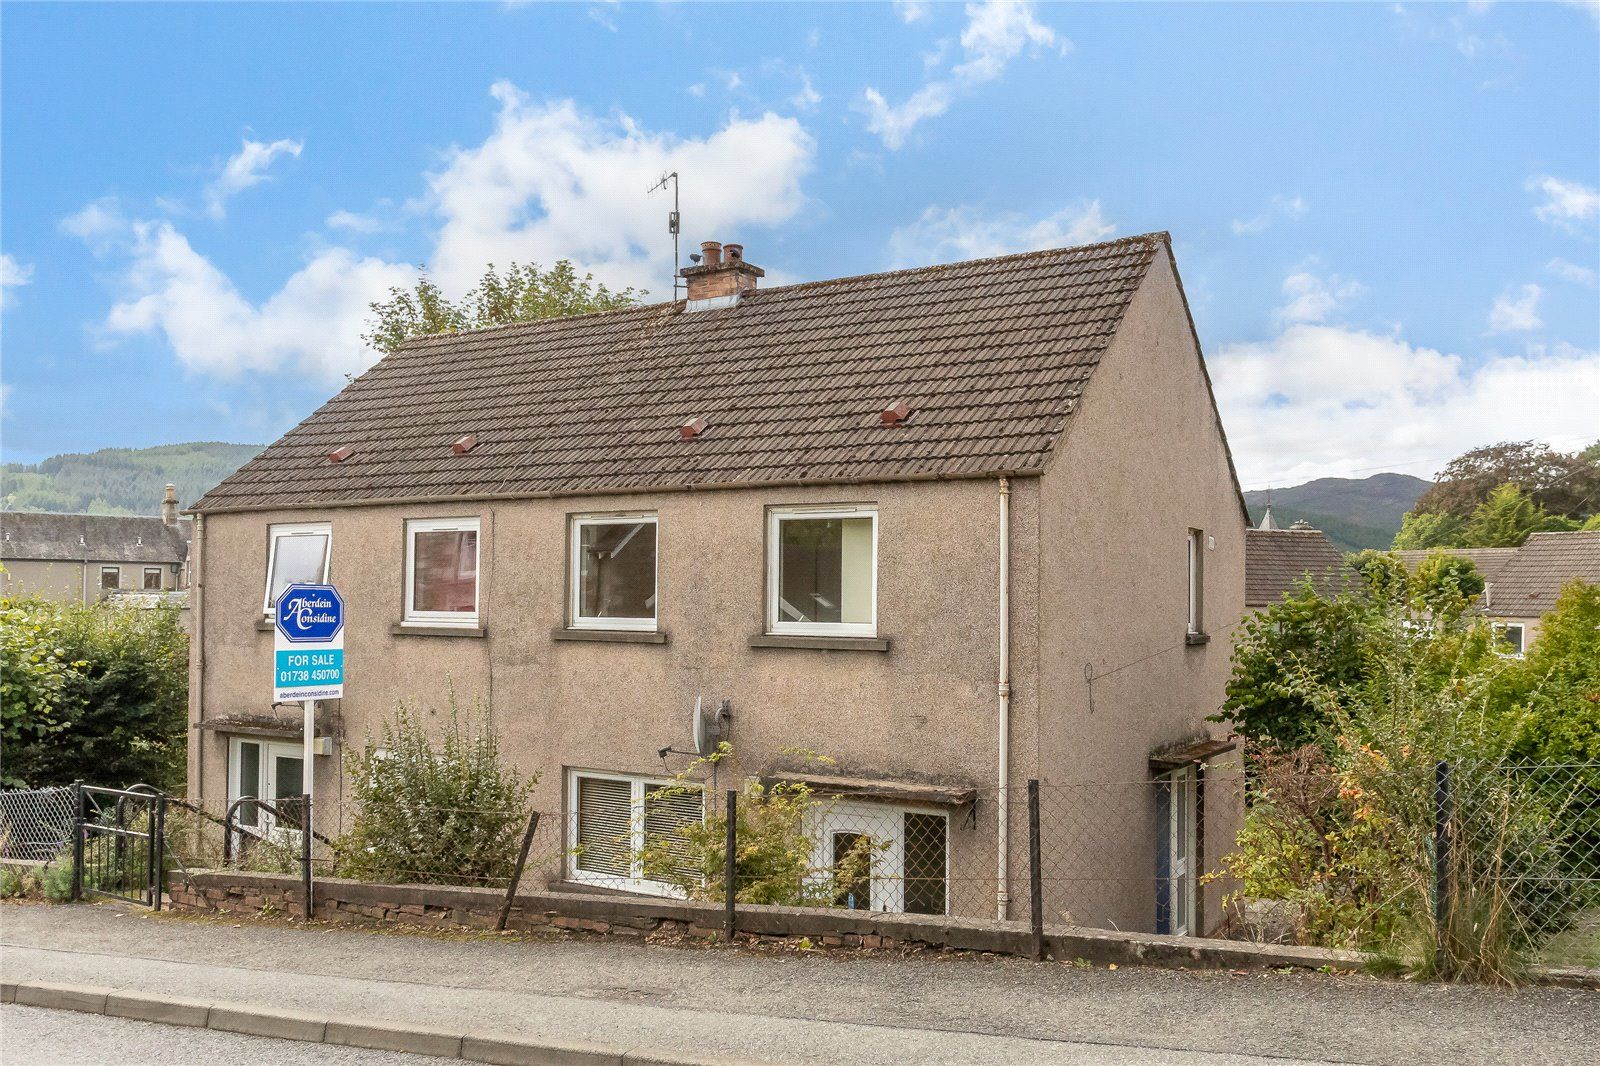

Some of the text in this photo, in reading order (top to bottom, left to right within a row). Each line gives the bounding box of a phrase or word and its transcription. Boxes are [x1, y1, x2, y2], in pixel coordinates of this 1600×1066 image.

[283, 597, 332, 621] Aberdein
[297, 607, 337, 630] Considine
[288, 654, 334, 667] FOR SALE
[280, 669, 340, 682] 01738 450700
[279, 689, 340, 699] aberdeinconsidine.com
